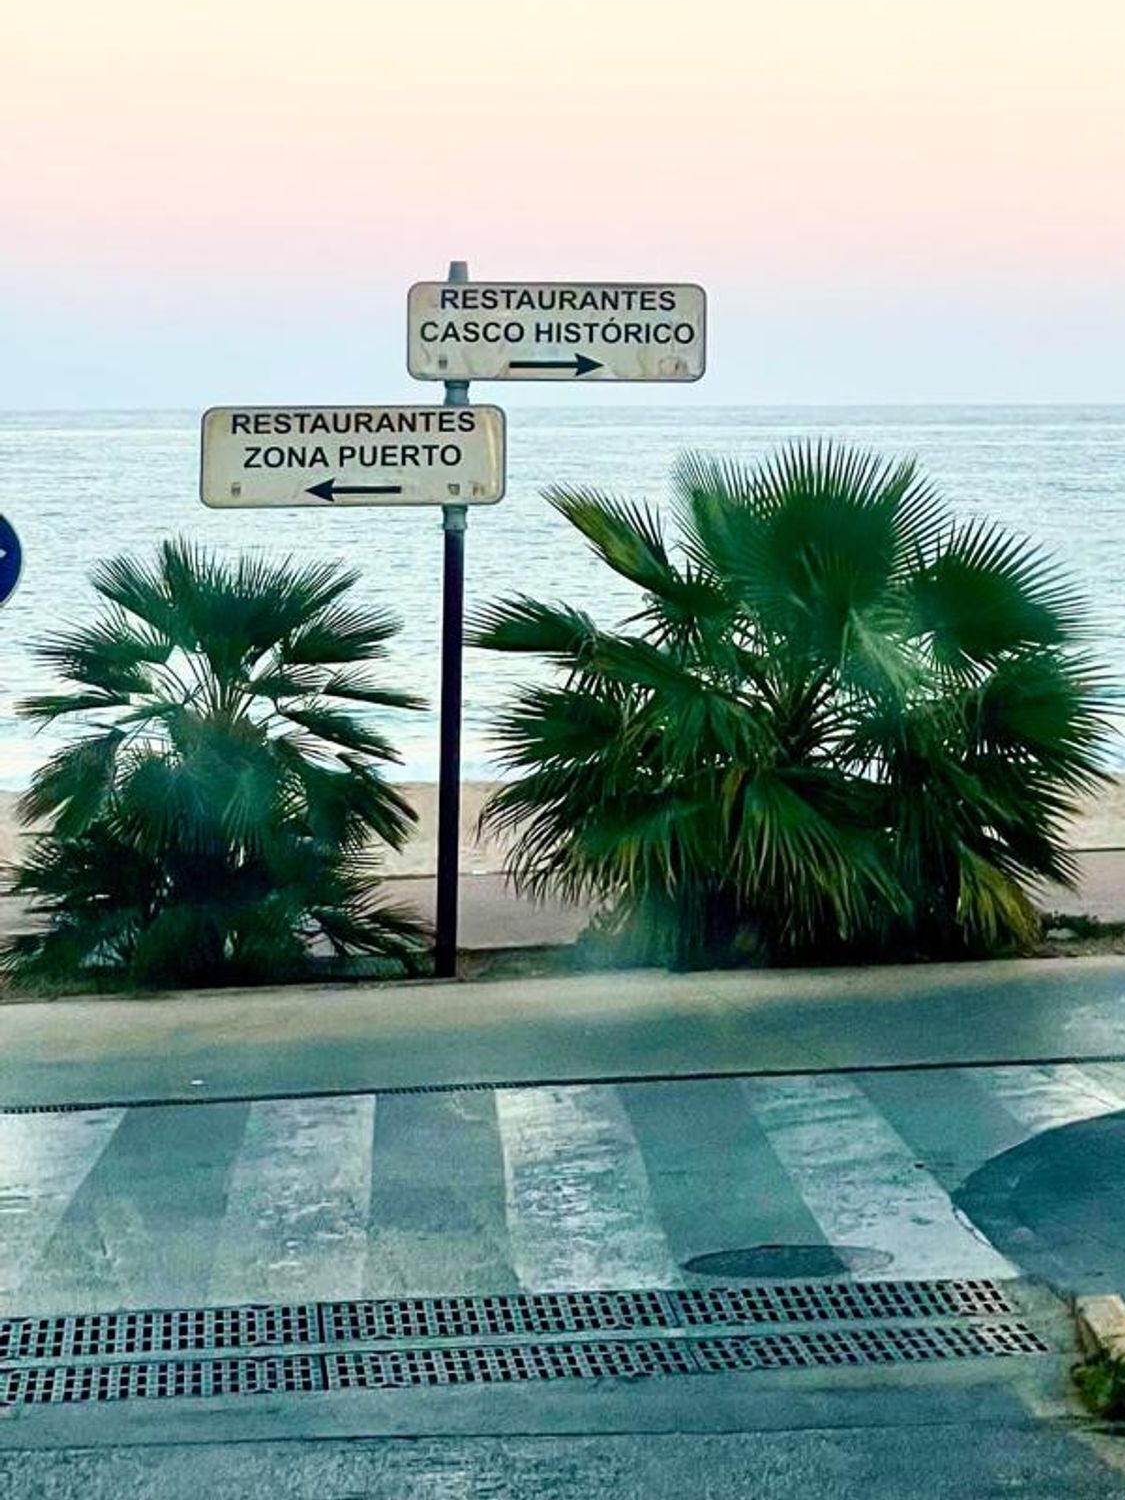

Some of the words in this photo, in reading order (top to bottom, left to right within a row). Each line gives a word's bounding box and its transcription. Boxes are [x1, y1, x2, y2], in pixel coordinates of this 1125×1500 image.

[440, 289, 677, 312] RESTAURANTES
[420, 321, 525, 344] CASCO
[535, 317, 695, 345] HISTÓRICO
[231, 411, 476, 435] RESTAURANTES
[243, 446, 330, 469] ZONA
[339, 444, 462, 468] PUERTO
